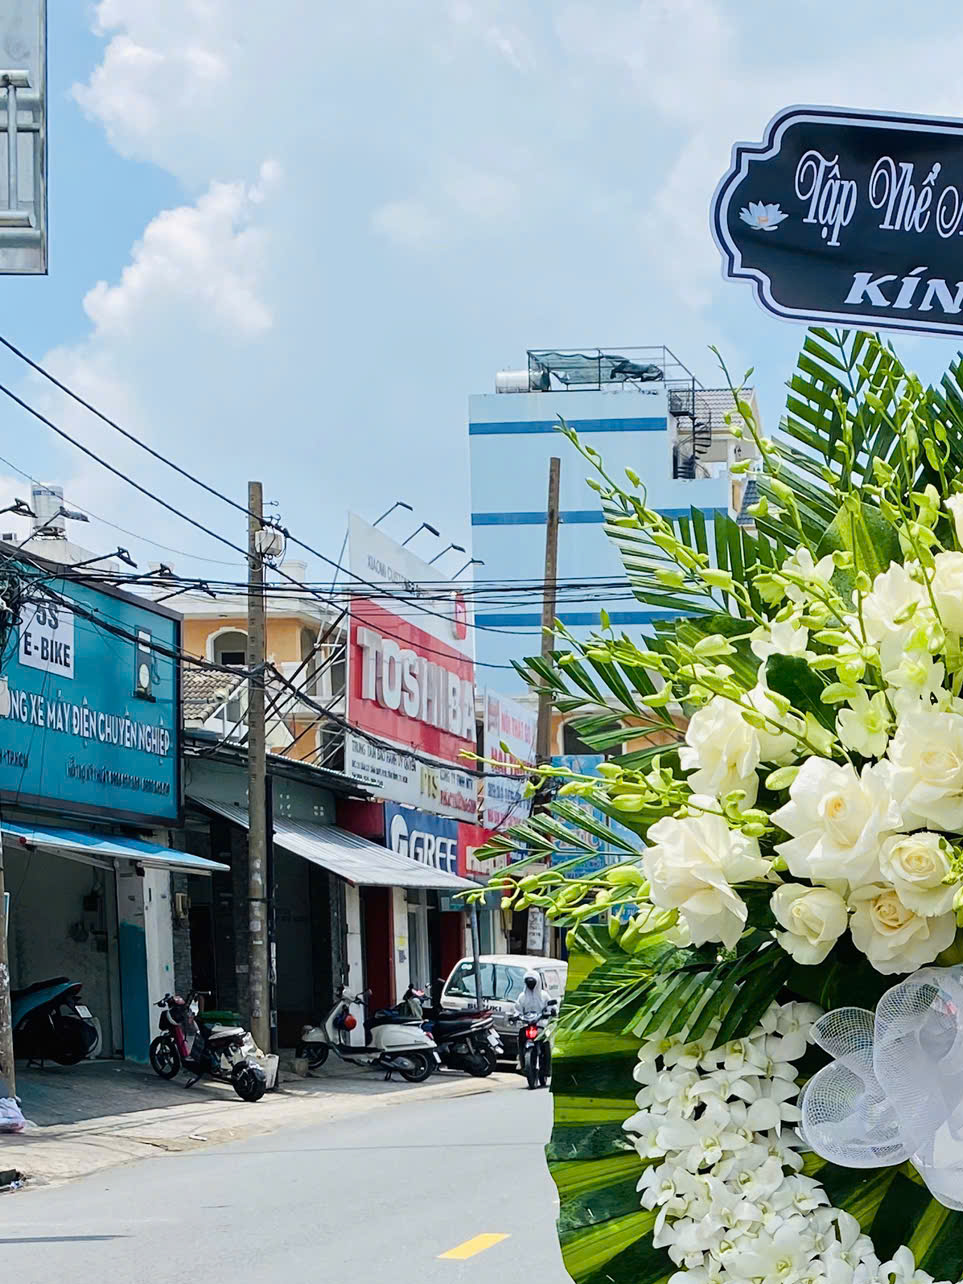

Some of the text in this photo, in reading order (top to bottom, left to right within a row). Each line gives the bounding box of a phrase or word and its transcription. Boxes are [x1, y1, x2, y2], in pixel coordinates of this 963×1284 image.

[795, 150, 857, 247] Tập
[29, 693, 45, 728] XE
[46, 689, 71, 733] MÁY
[72, 696, 97, 748] ĐIỆN
[98, 705, 137, 749] CHUYÊN
[138, 716, 170, 766] NGHIỆP
[356, 626, 476, 740] TOSHIBA
